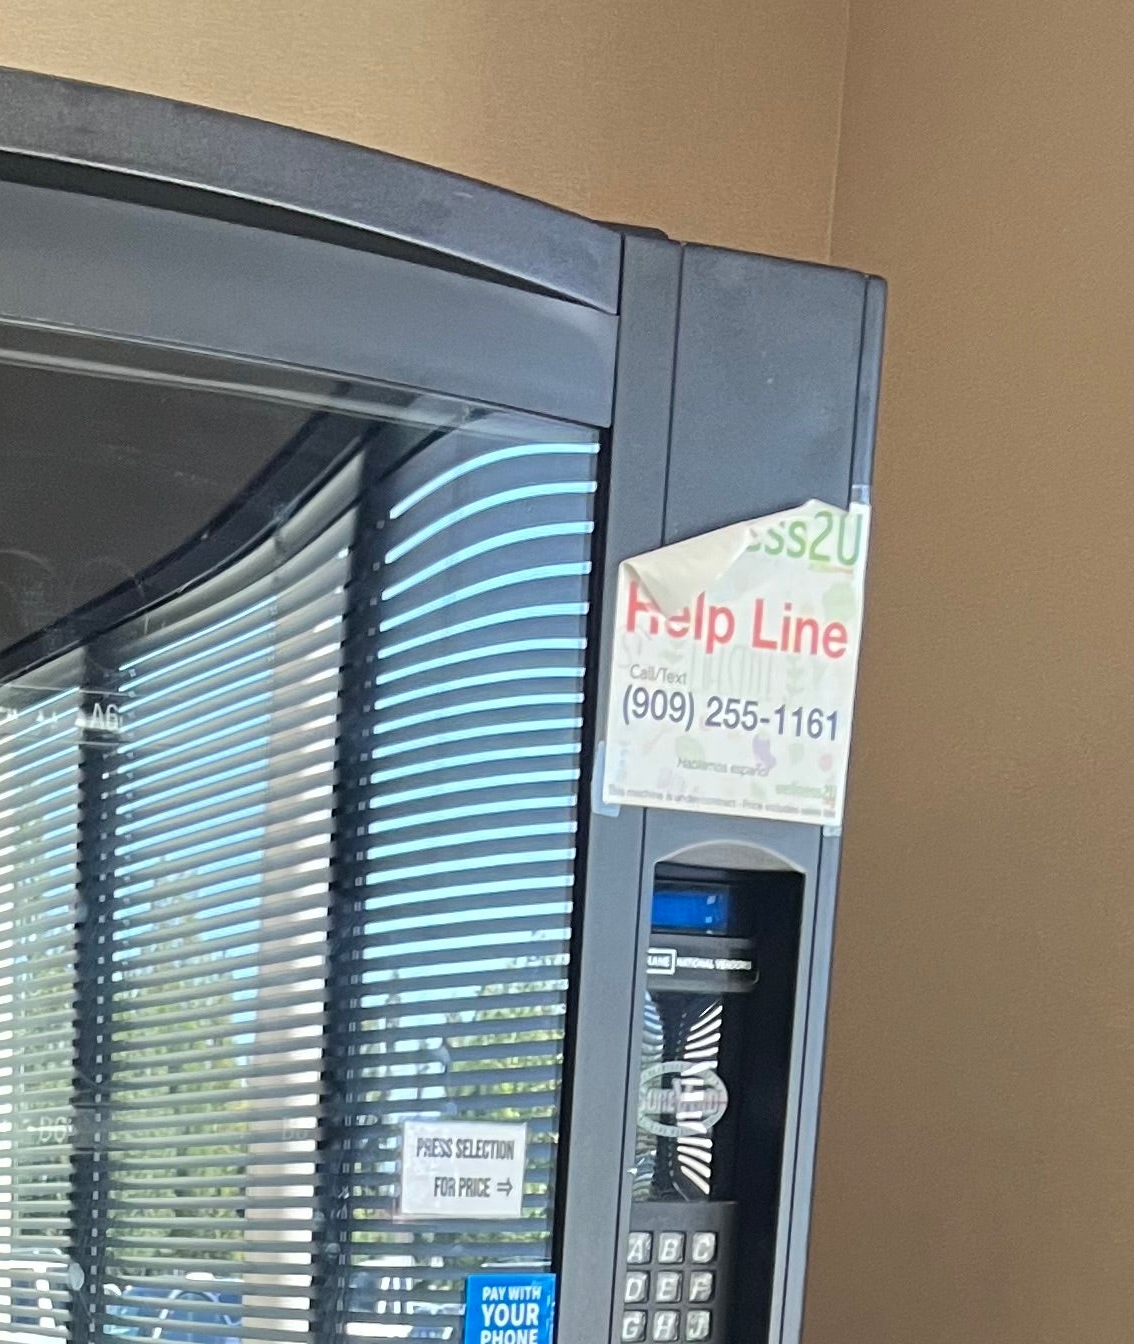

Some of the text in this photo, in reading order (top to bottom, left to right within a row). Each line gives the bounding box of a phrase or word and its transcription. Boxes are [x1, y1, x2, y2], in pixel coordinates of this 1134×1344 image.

[626, 580, 849, 659] Help Line
[629, 664, 687, 686] Call/Text
[622, 684, 839, 742] (909) 255-1161
[416, 1137, 515, 1161] PRESS SELECTION
[433, 1176, 491, 1198] FOR PRICE
[482, 1286, 542, 1301] PAY WITH
[481, 1303, 540, 1328] YOUR
